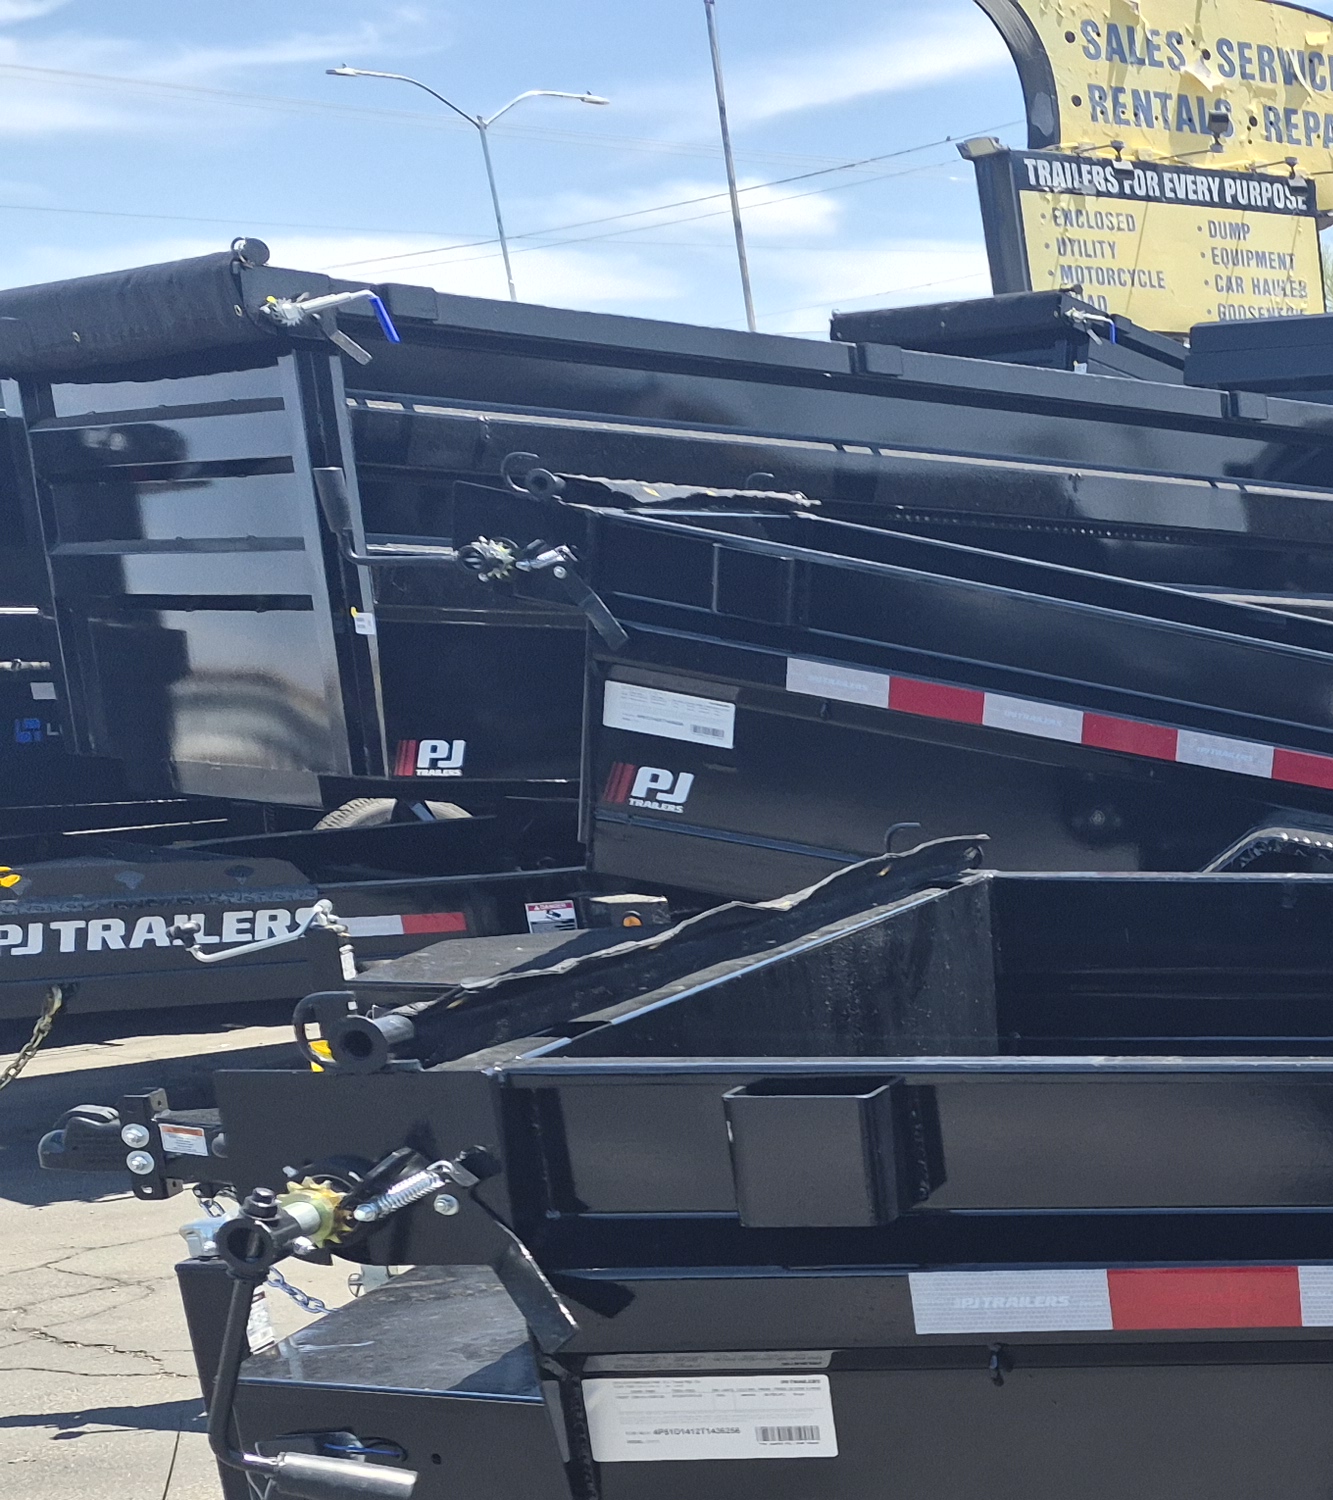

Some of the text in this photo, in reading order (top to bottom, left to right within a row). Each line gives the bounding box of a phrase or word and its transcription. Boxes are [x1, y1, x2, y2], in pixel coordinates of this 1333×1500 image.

[1080, 19, 1186, 71] SALES
[1087, 83, 1235, 138] RENTALS
[1023, 158, 1119, 193] TRAILERS
[1162, 172, 1220, 203] EVERY
[1223, 178, 1307, 210] PURPOSE
[1052, 207, 1136, 232] ENCLOSED
[1208, 219, 1250, 241] DUMP
[1056, 236, 1116, 259] UTILITY
[1211, 246, 1295, 271] EQUIPMENT
[1060, 264, 1166, 289] MOTORCYCLE
[1214, 274, 1245, 294] CAR
[417, 740, 466, 768] PJ
[631, 766, 695, 804] PJ
[629, 798, 684, 813] TRAILERS
